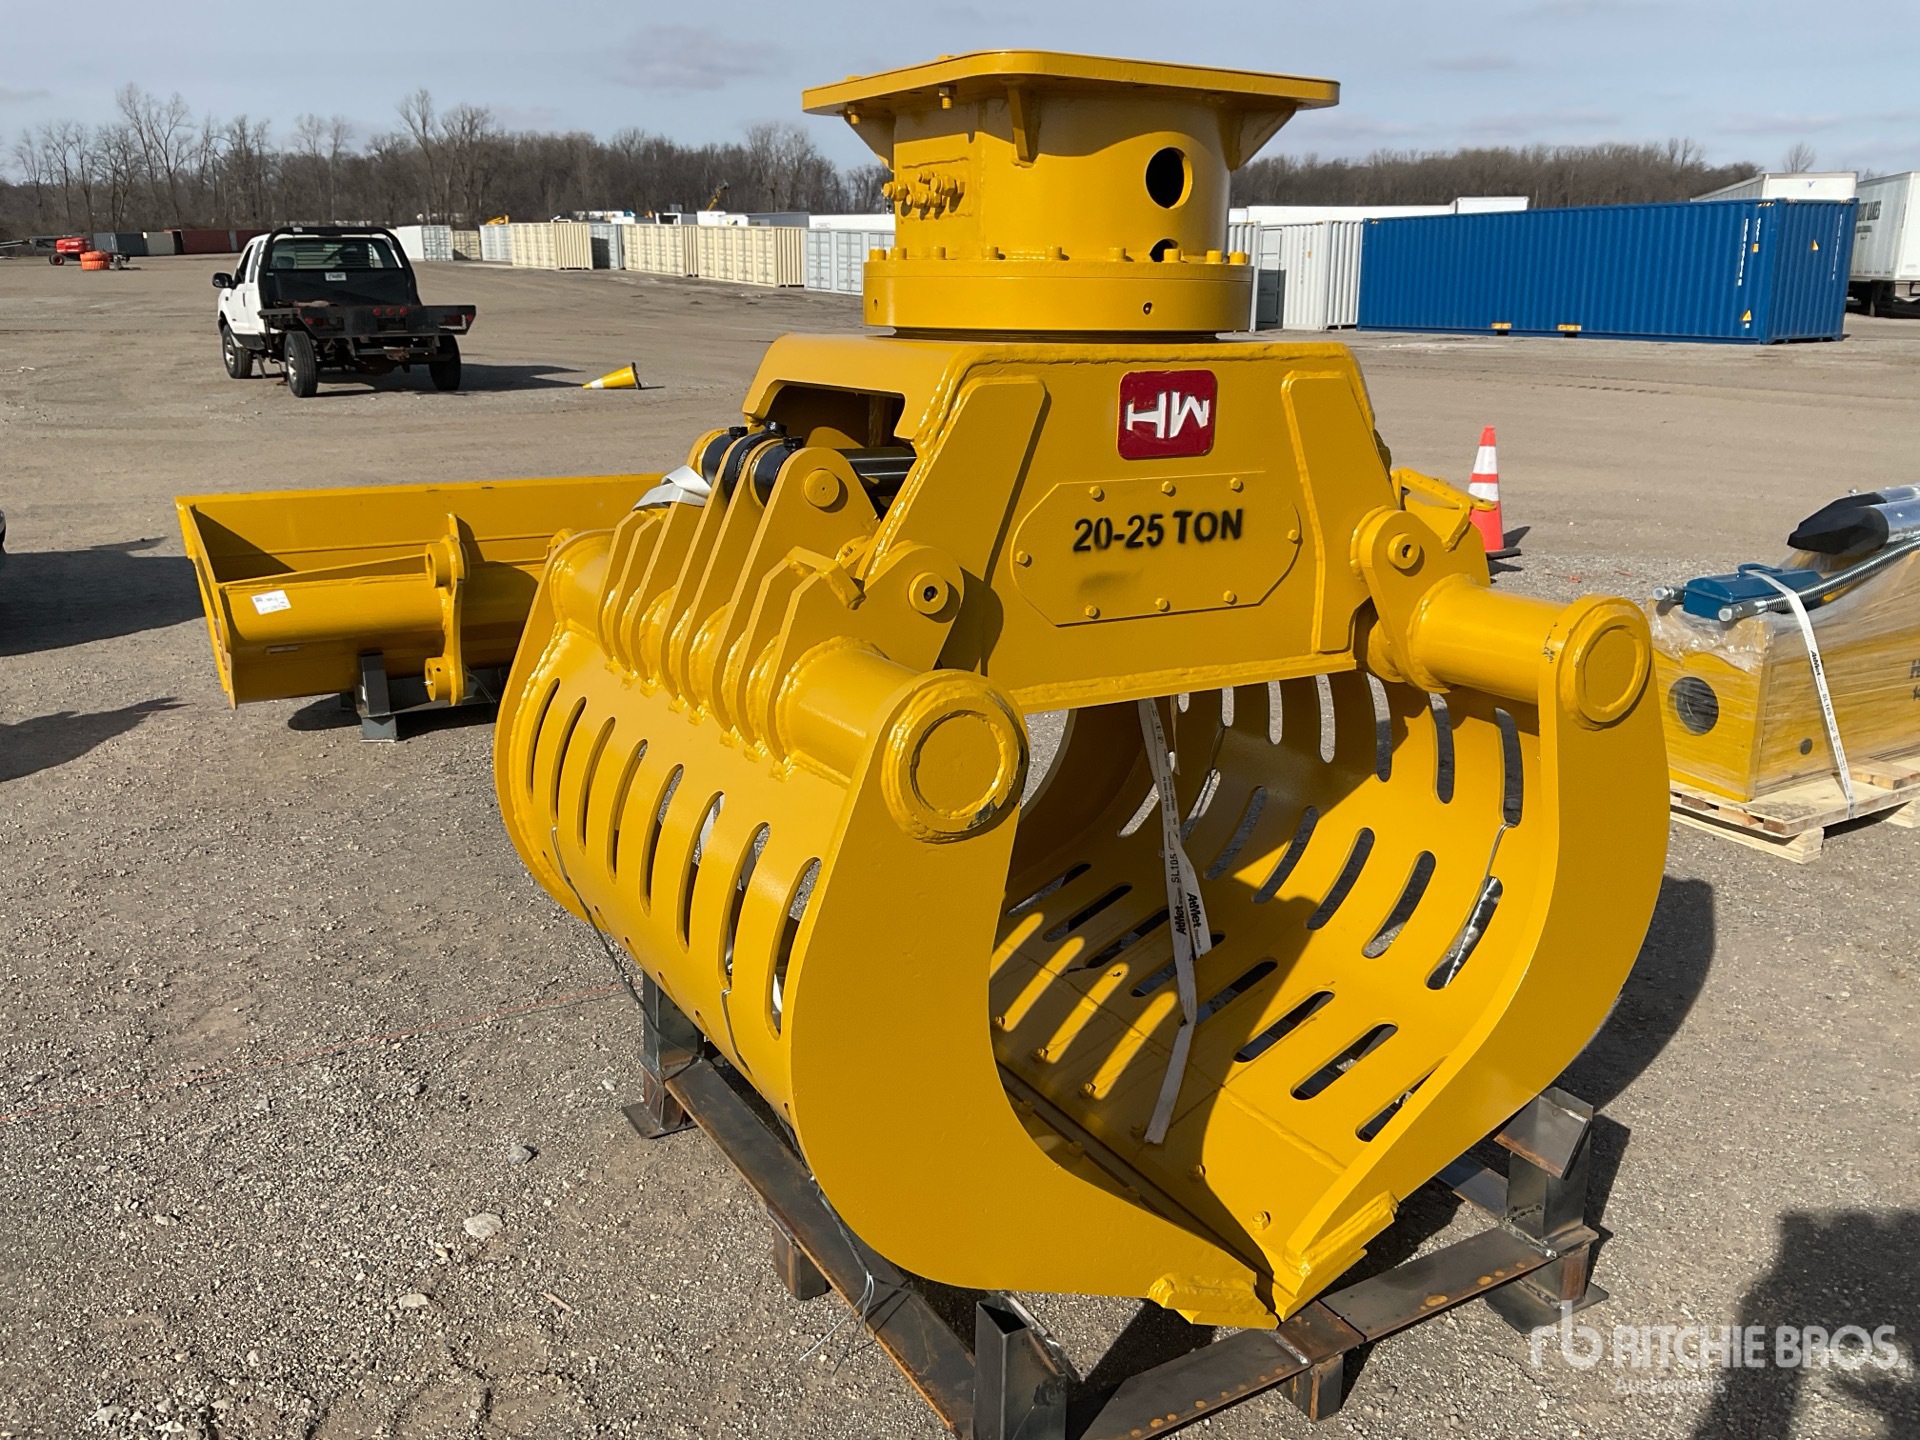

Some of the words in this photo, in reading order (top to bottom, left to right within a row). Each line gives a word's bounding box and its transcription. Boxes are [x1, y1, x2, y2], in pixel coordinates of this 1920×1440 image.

[1073, 513, 1164, 552] 20-25
[1173, 508, 1243, 544] TON
[1174, 906, 1187, 935] AtMet
[1186, 892, 1201, 928] AtMet
